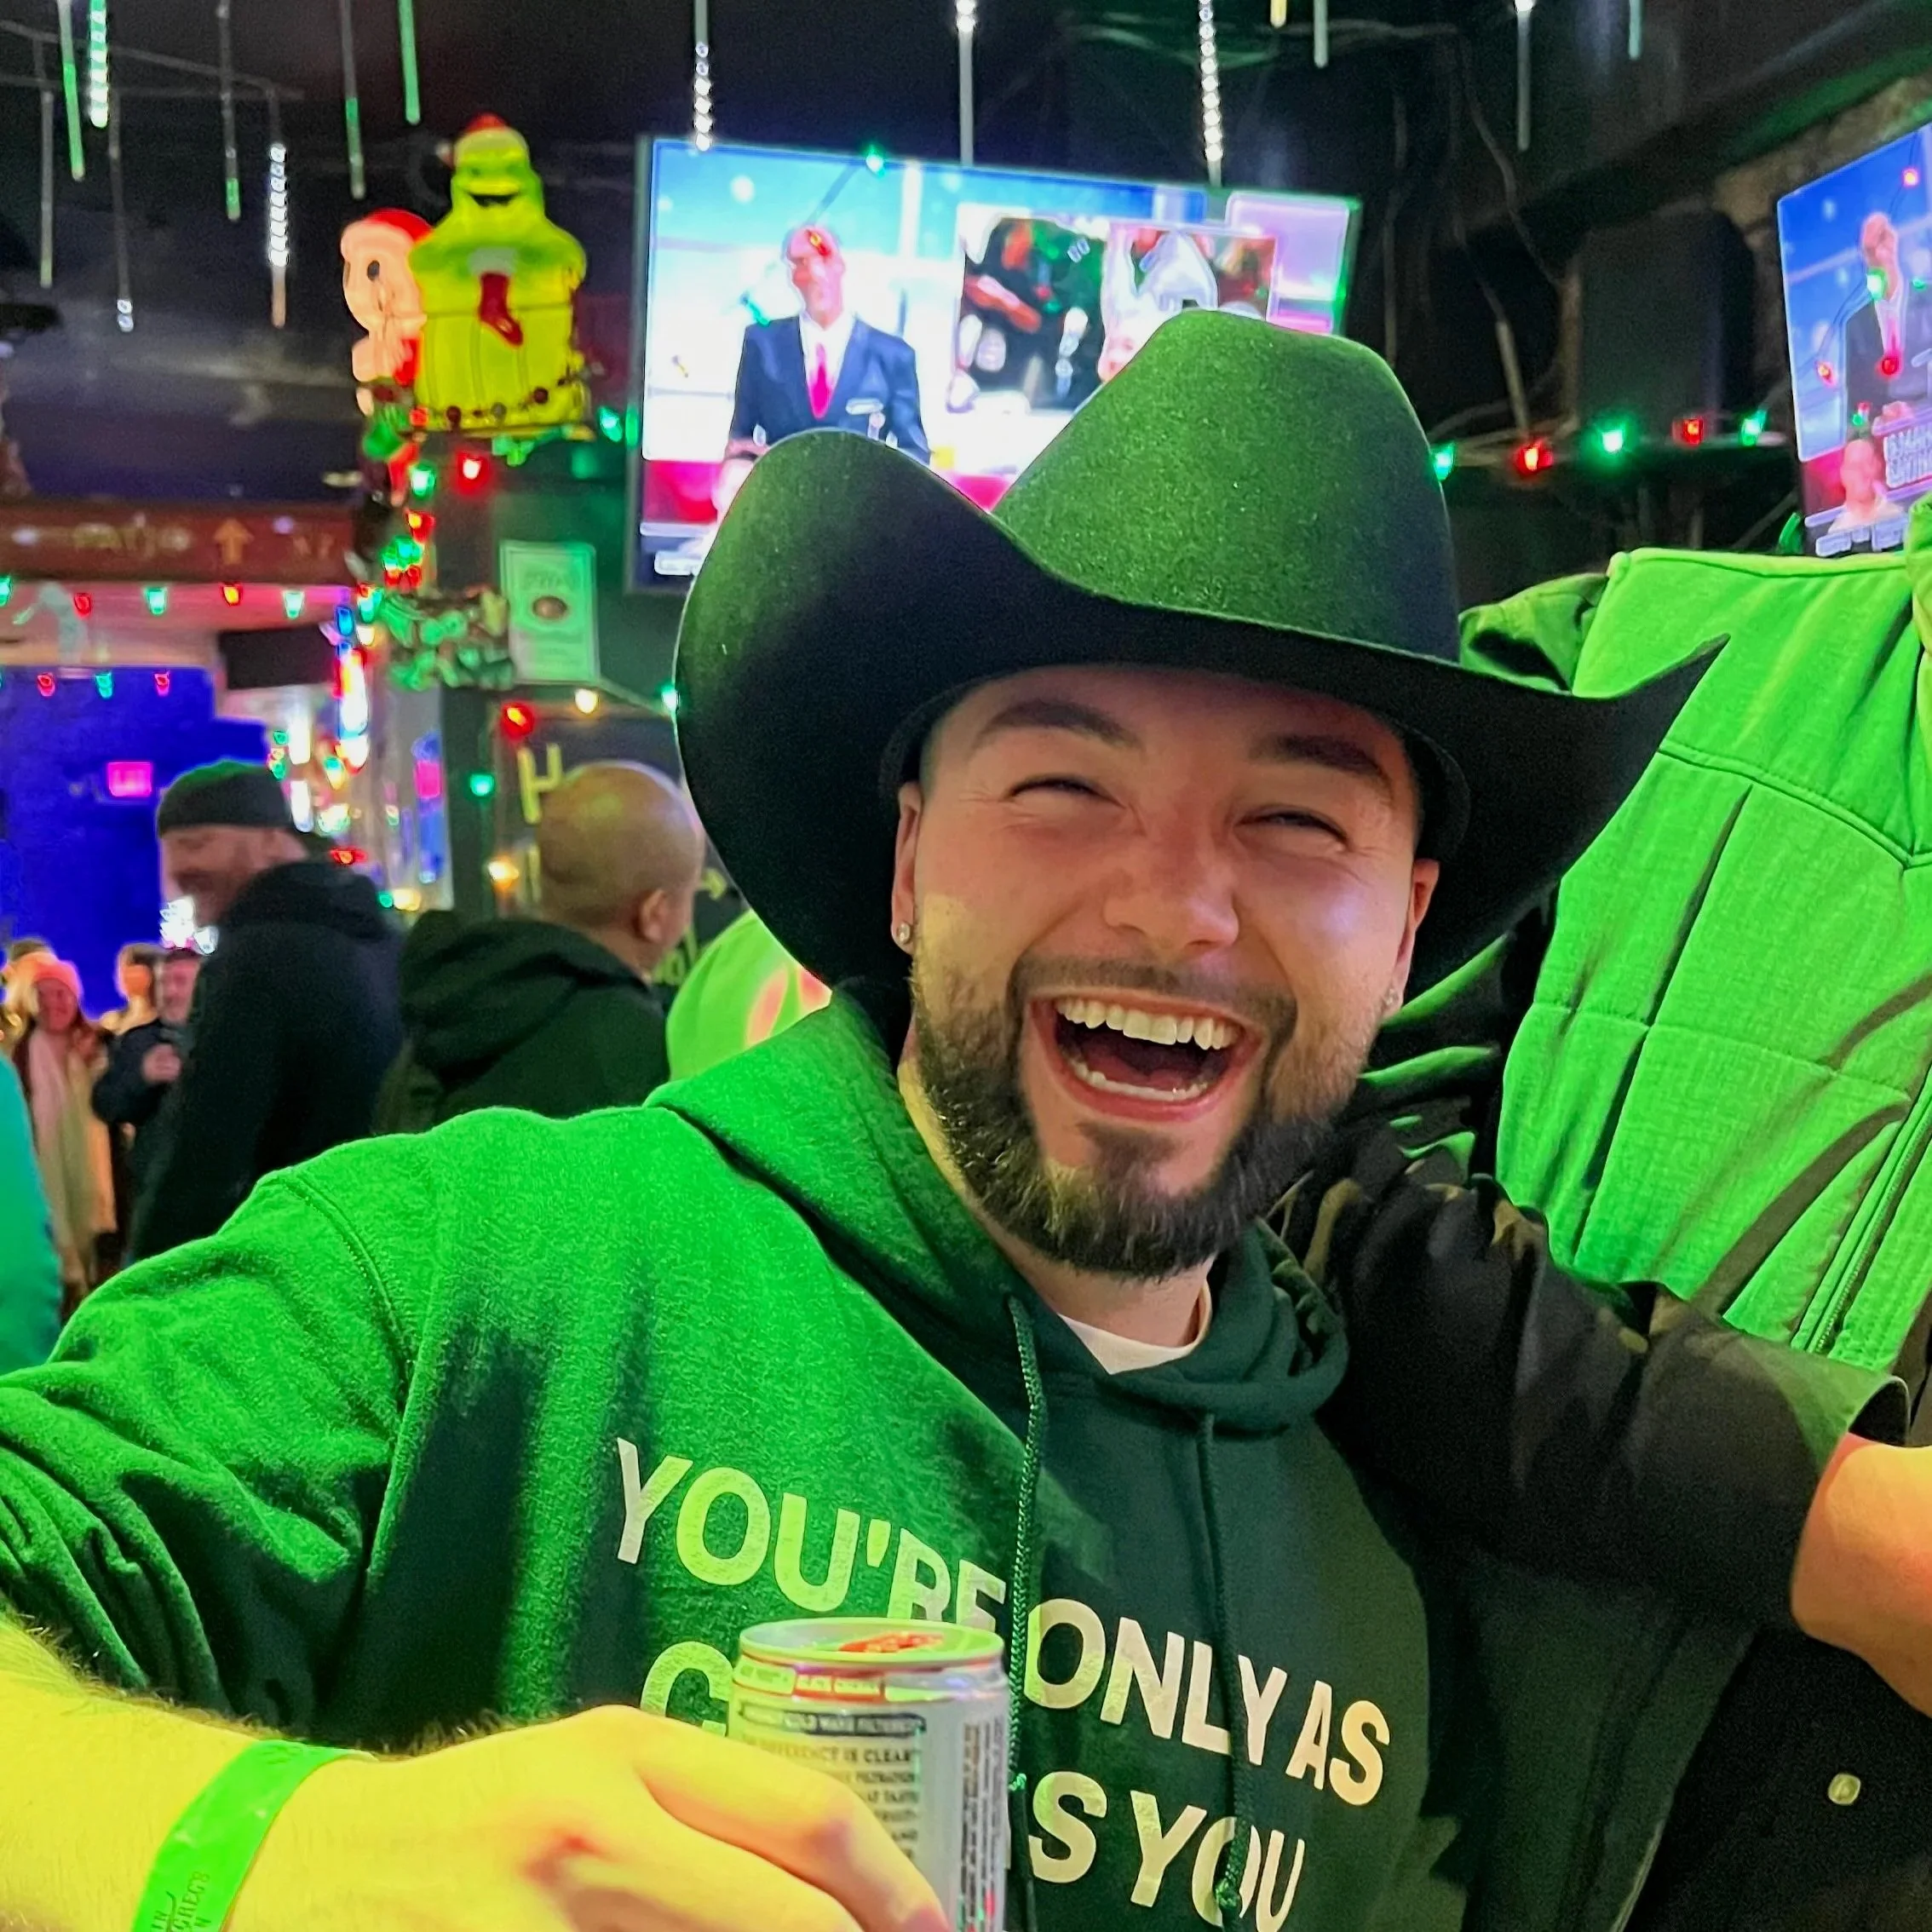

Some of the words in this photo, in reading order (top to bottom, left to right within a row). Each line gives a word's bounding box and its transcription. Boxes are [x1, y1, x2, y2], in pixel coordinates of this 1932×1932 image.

[618, 1437, 1005, 1632] YOU'RE
[1025, 1598, 1287, 1766] ONLY
[1285, 1680, 1390, 1806] AS
[1130, 1791, 1305, 1932] YOU
